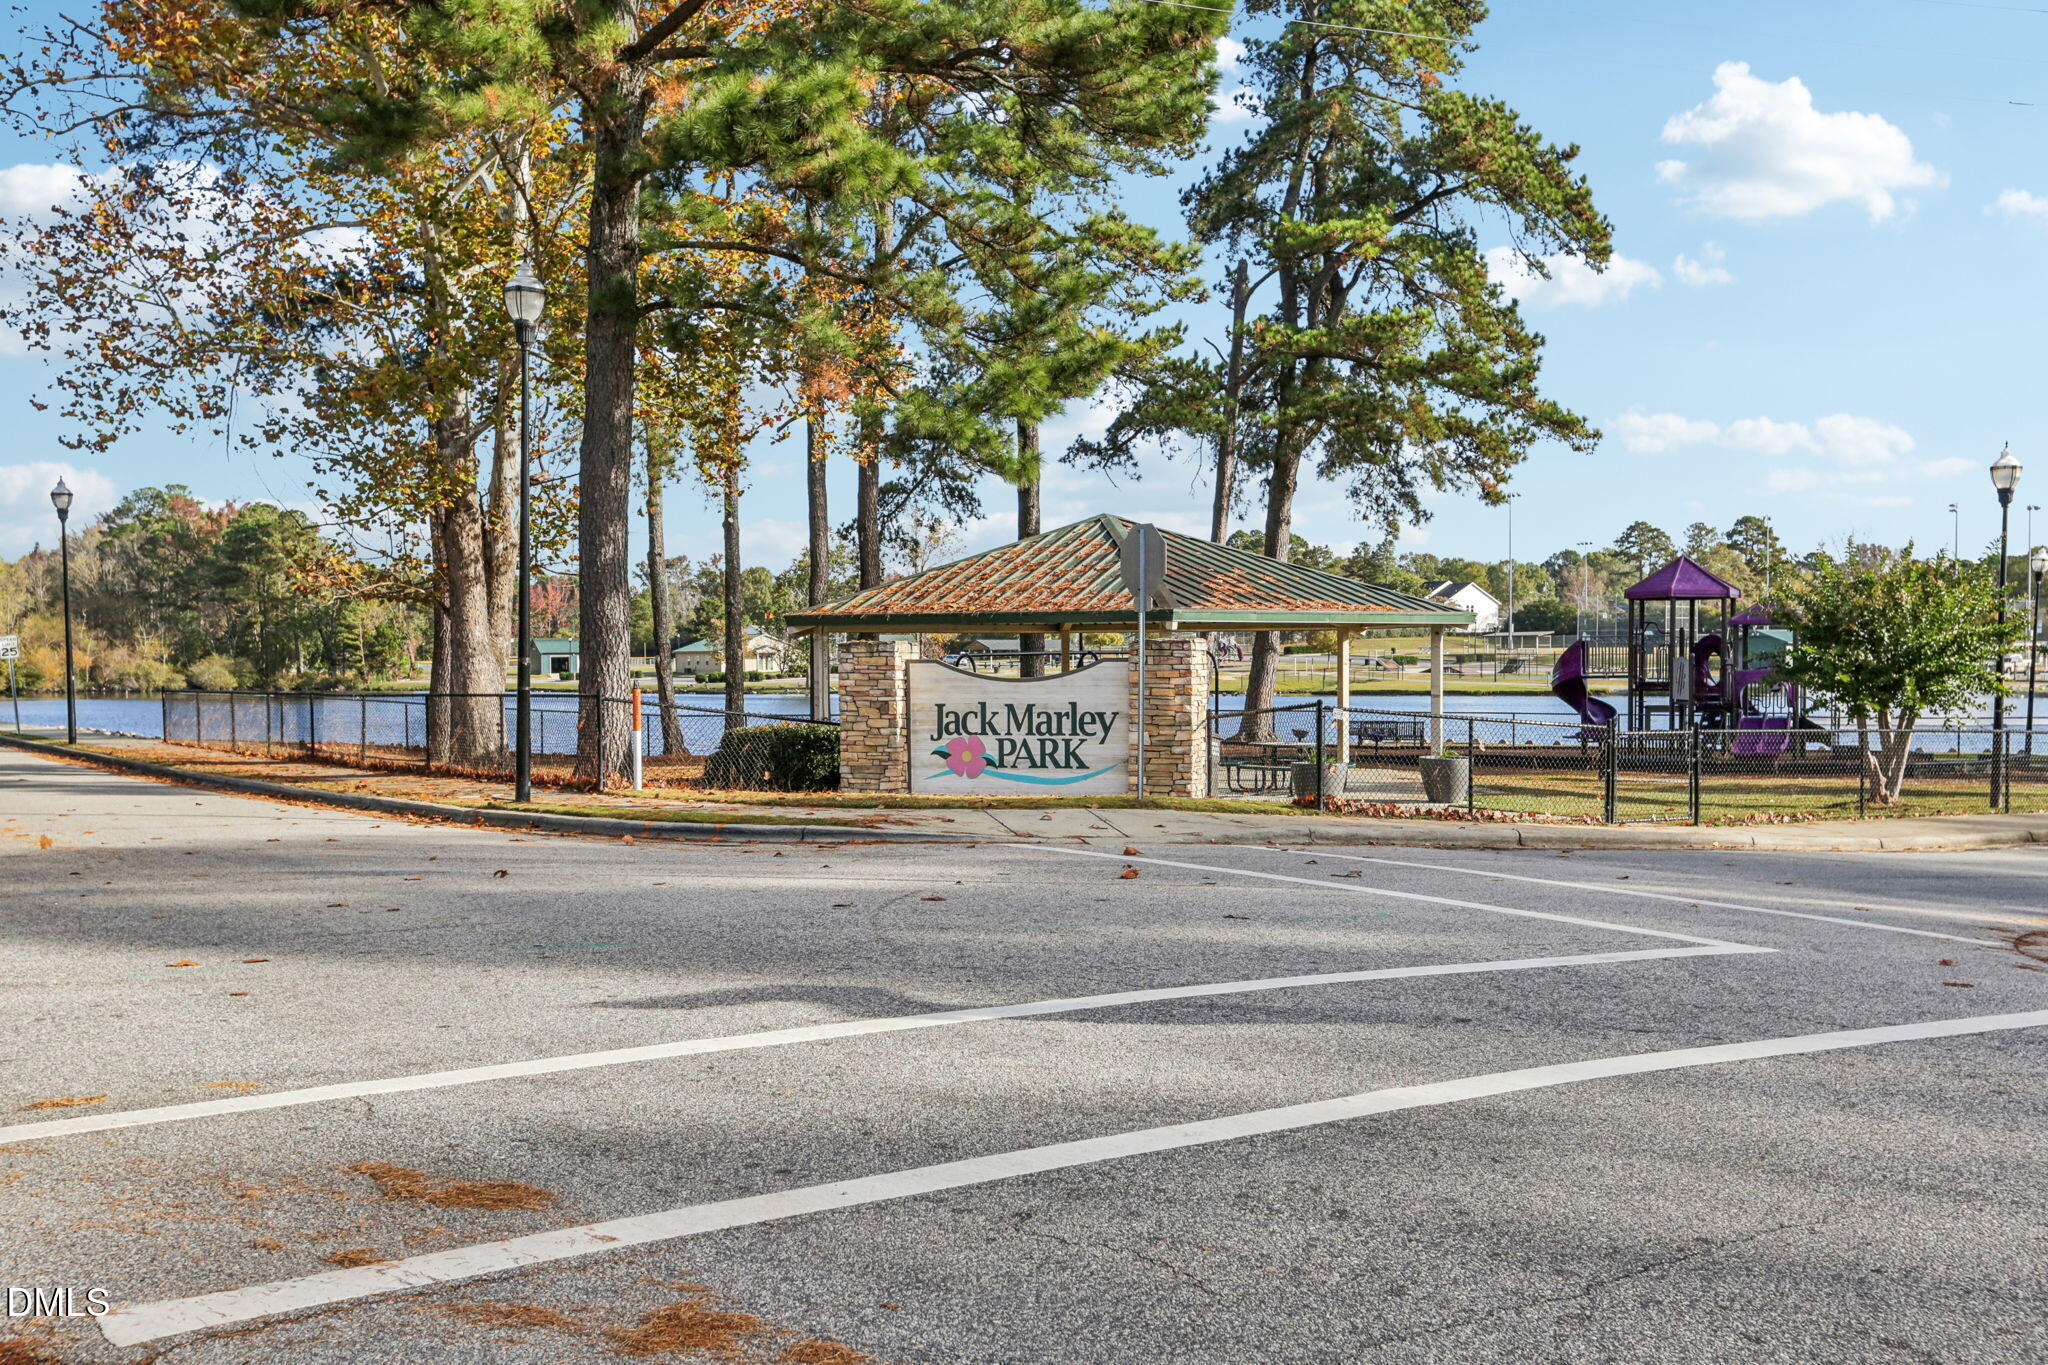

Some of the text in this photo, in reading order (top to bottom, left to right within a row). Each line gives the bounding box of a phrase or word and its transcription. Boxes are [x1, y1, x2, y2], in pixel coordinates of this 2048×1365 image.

[2, 647, 17, 656] 25
[930, 701, 1119, 744] Jack Marley
[995, 738, 1090, 769] PARK
